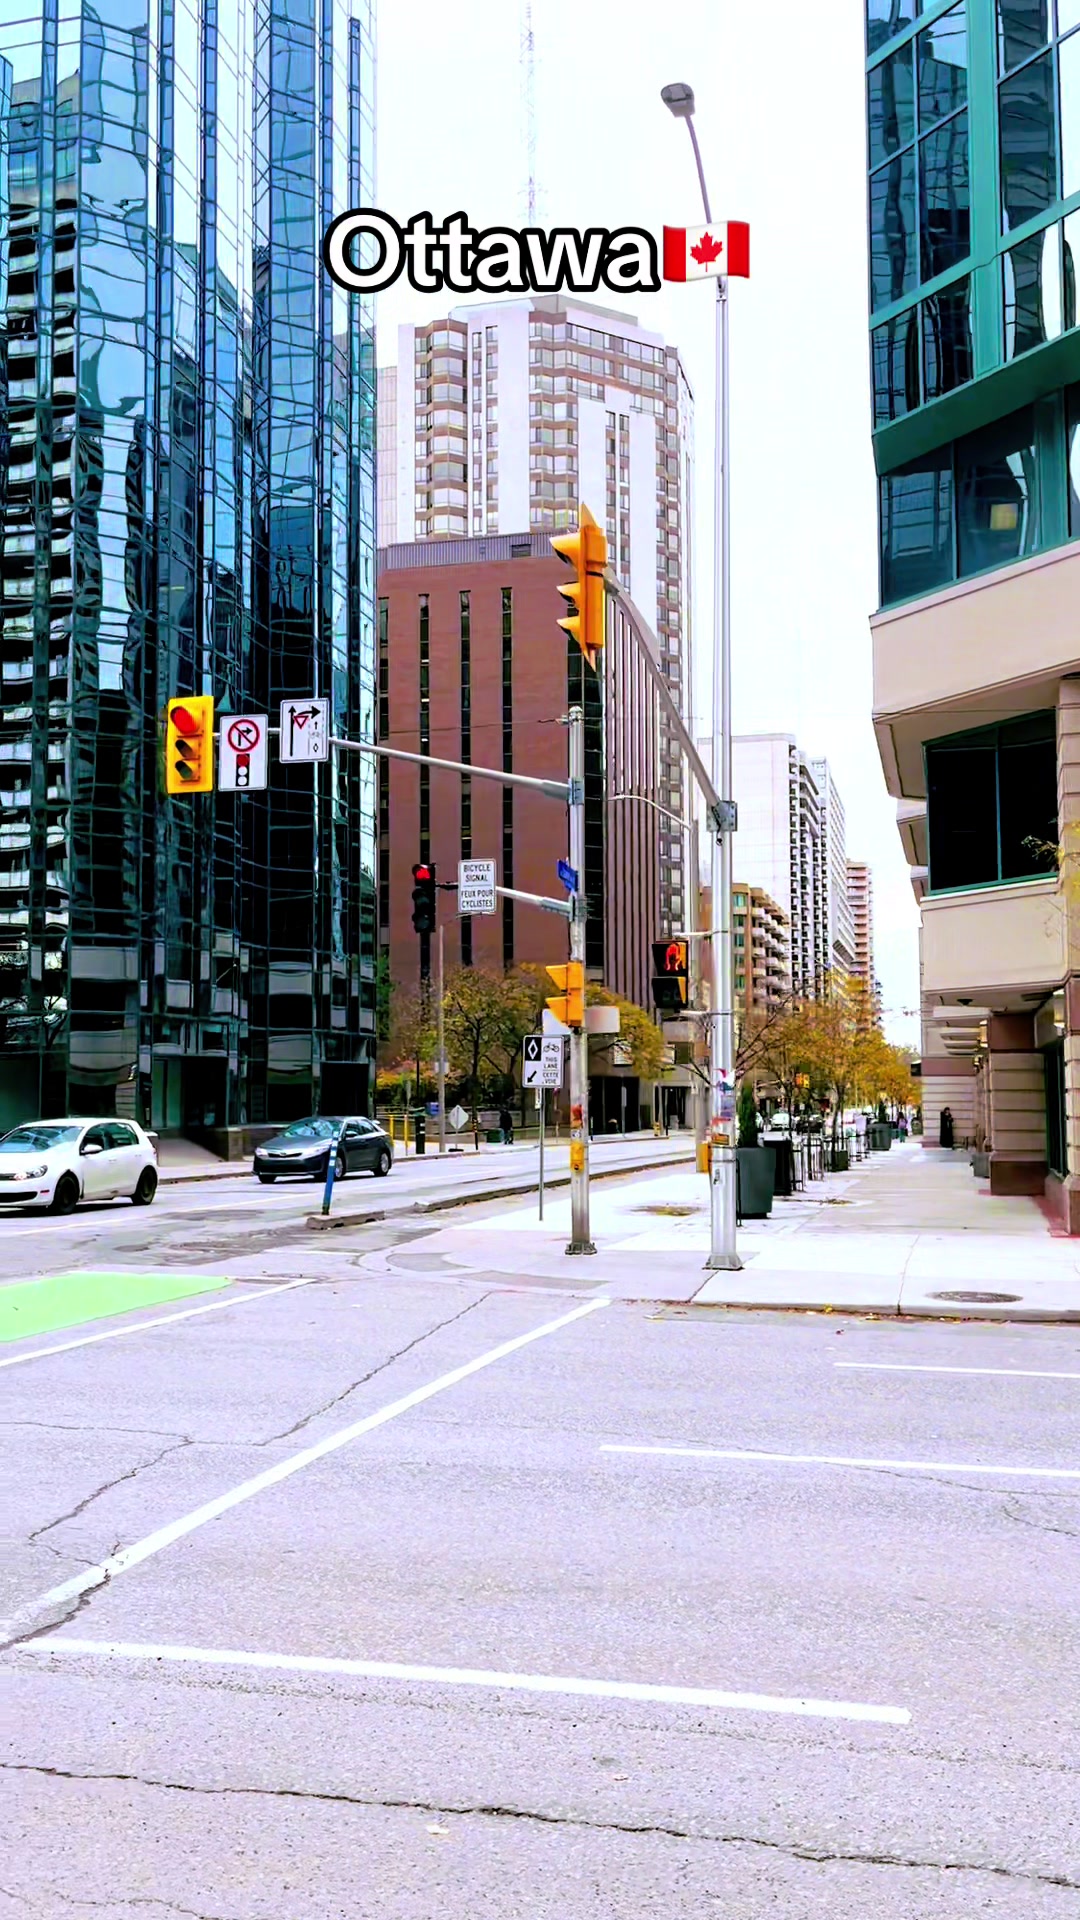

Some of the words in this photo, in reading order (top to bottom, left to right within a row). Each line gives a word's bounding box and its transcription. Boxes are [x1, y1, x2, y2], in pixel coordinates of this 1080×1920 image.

[464, 864, 491, 872] BICYCLE
[465, 874, 488, 882] SIGNAL
[461, 890, 476, 898] FEUX
[477, 889, 493, 897] POUR
[462, 899, 493, 908] CYCLISTES
